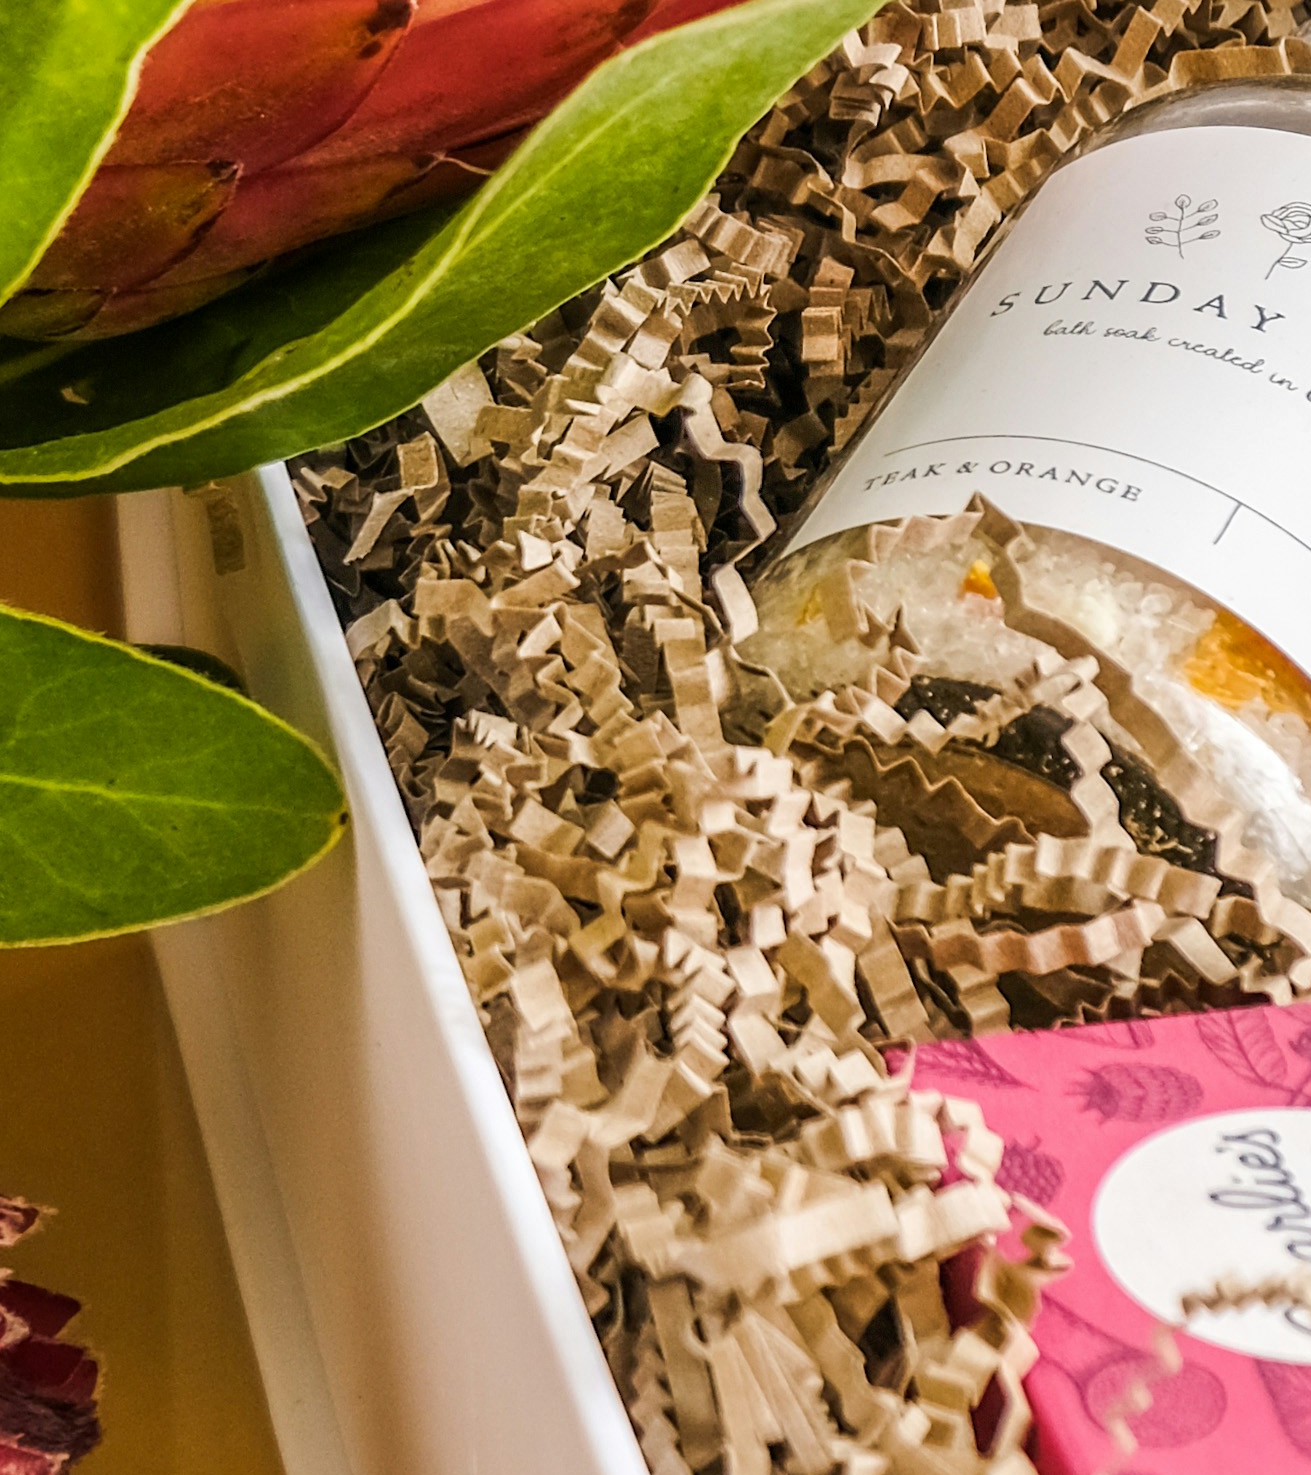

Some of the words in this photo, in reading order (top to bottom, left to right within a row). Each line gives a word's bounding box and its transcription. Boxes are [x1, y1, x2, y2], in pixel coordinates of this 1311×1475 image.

[990, 279, 1285, 334] SUNDAY
[1043, 319, 1096, 337] bath
[1103, 323, 1162, 342] soak
[1167, 336, 1264, 375] created
[1269, 371, 1299, 392] in
[863, 462, 945, 492] TEAK
[955, 460, 979, 475] &
[988, 459, 1144, 502] ORANGE
